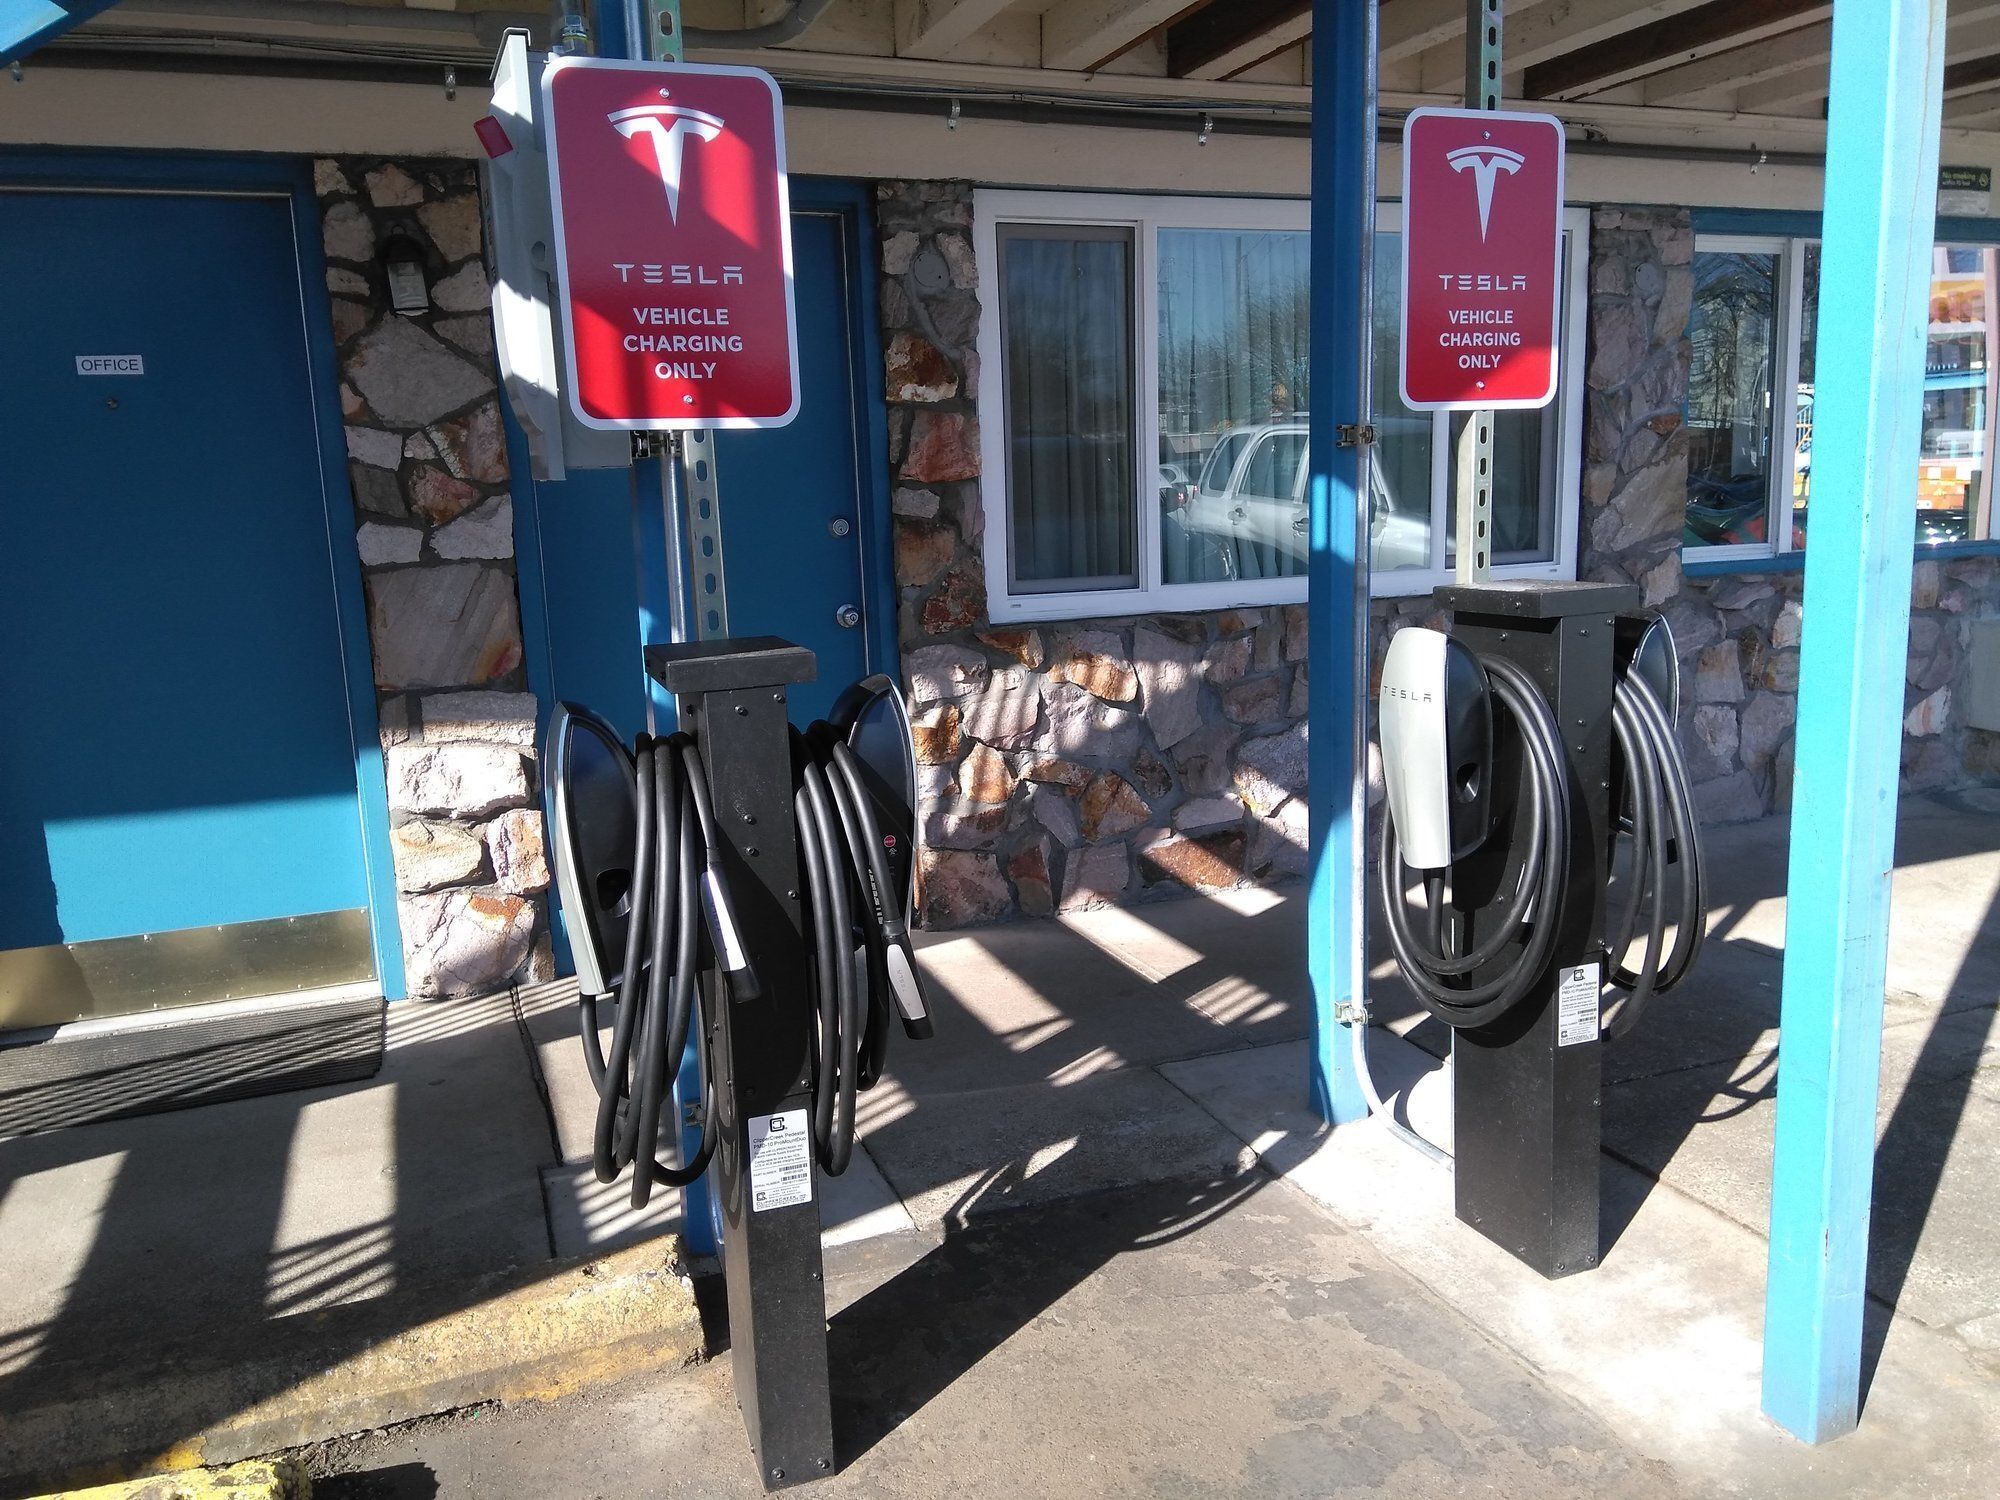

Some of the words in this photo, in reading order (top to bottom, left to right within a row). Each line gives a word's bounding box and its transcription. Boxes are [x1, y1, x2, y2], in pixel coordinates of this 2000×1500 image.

[612, 264, 743, 285] TESLA
[1438, 274, 1527, 291] TESLA
[632, 308, 730, 325] VEHICLE
[1448, 310, 1514, 324] VEHICLE
[623, 335, 743, 353] CHARGING
[1439, 332, 1521, 347] CHARGING
[81, 358, 140, 372] OFFICE
[1458, 354, 1502, 369] ONLY
[654, 362, 718, 380] ONLY
[1383, 685, 1432, 703] TESLA
